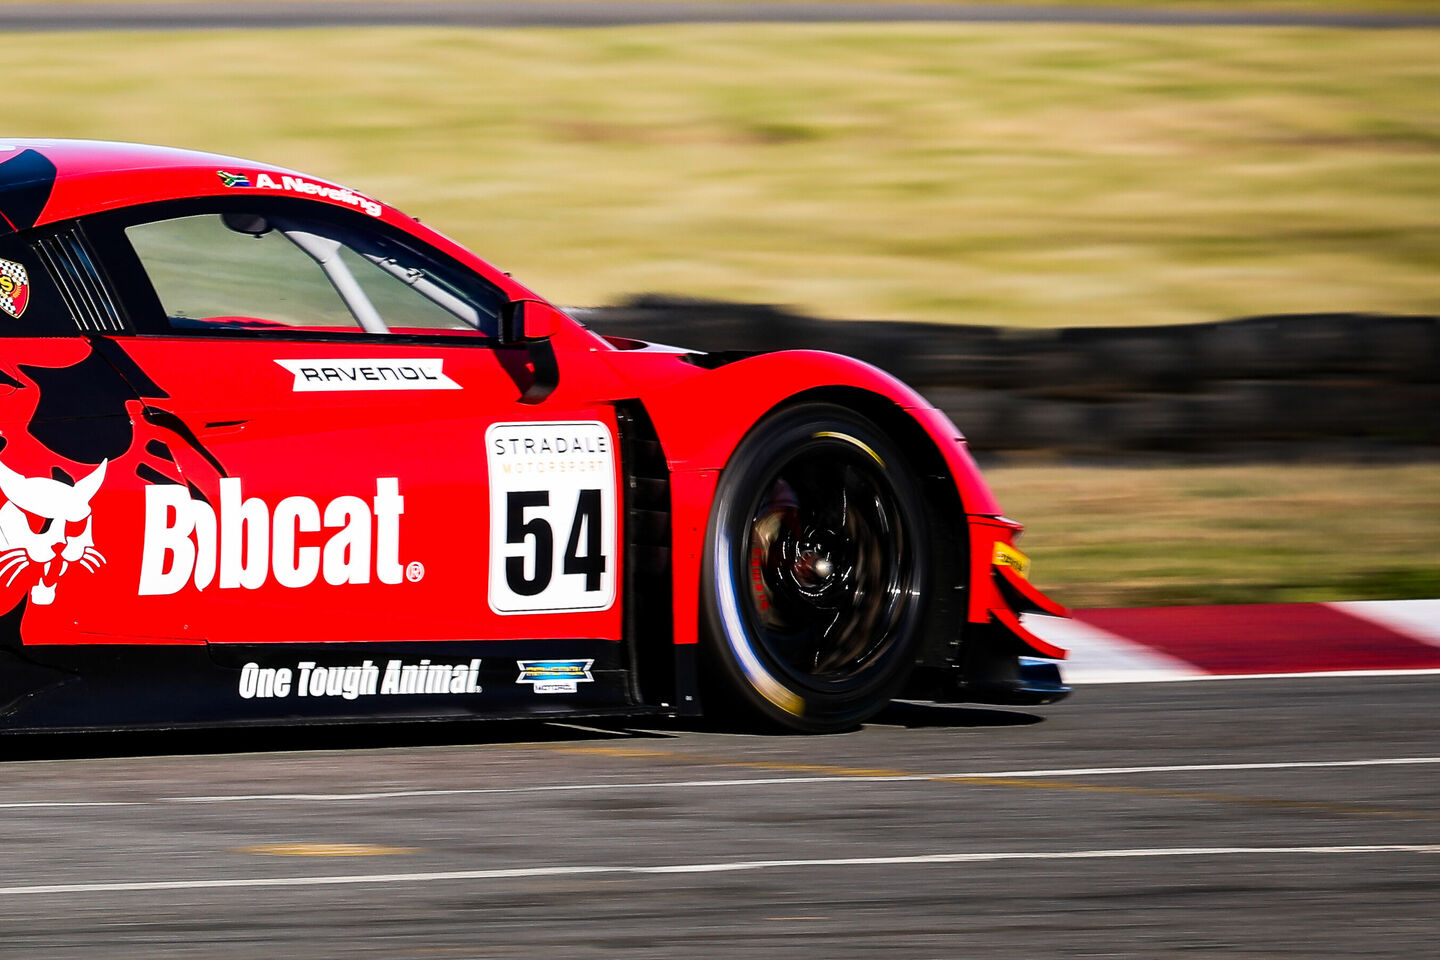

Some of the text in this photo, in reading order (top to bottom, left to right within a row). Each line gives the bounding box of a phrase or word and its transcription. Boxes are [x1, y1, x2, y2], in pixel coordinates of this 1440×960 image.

[300, 366, 438, 382] RAVENOL
[494, 436, 608, 456] STRADALE
[504, 489, 607, 597] 54
[238, 661, 293, 700] One
[297, 660, 380, 701] Tough
